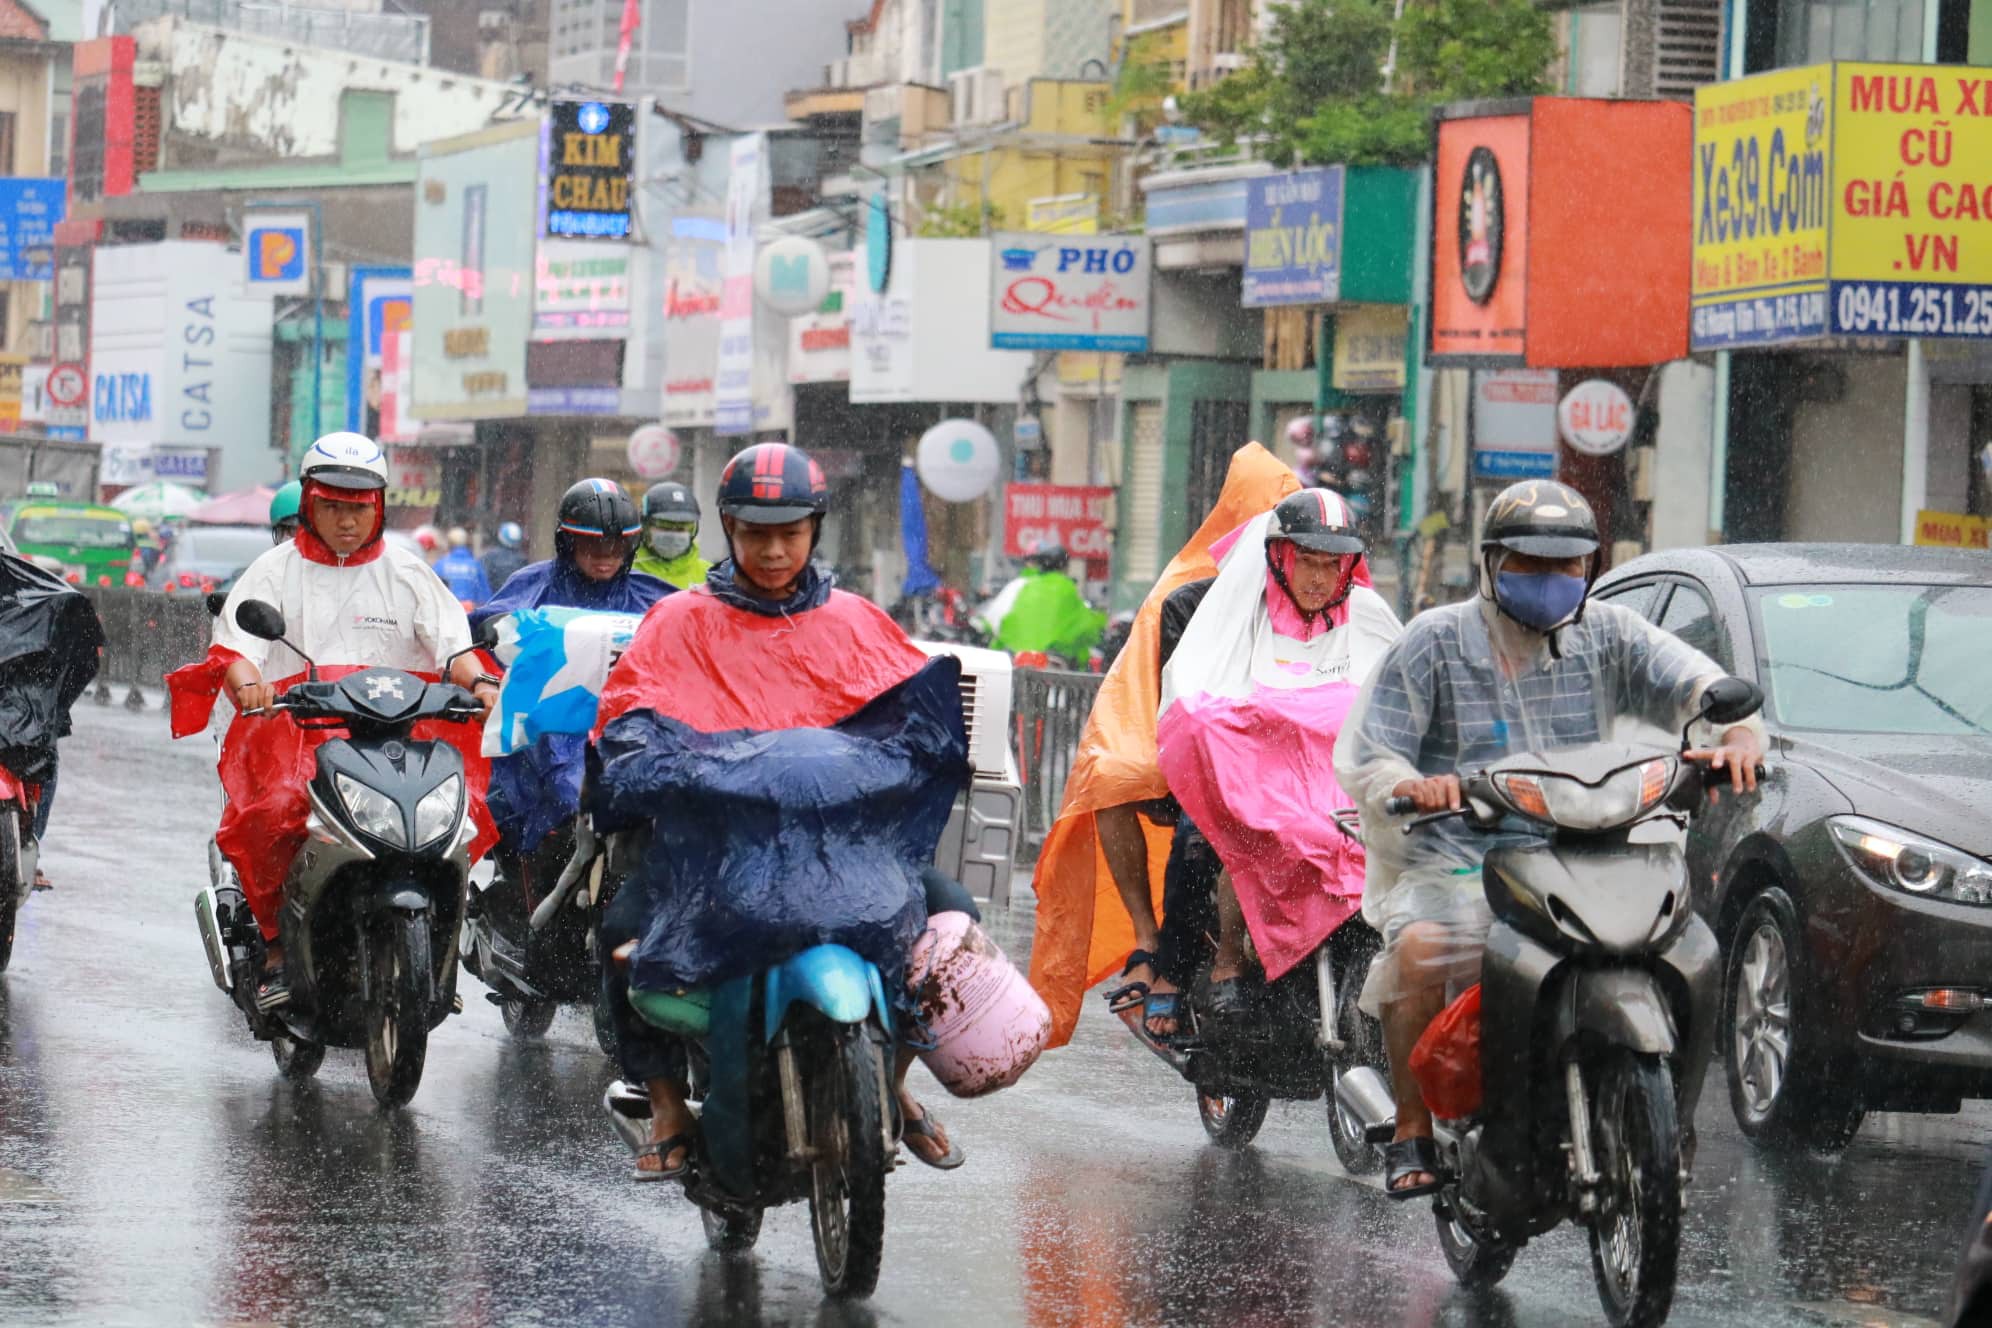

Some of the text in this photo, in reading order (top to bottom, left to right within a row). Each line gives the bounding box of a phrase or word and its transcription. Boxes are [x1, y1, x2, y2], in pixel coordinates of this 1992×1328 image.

[1850, 76, 1940, 113] MUA
[563, 132, 621, 167] KIM
[1900, 120, 1953, 167] CŨ
[553, 174, 628, 211] CHAU
[1699, 127, 1824, 245] Xe39.Com
[1845, 170, 1910, 218] GIÁ
[1893, 234, 1959, 272] .VN
[181, 296, 215, 431] CATSA
[94, 373, 152, 422] CATSA
